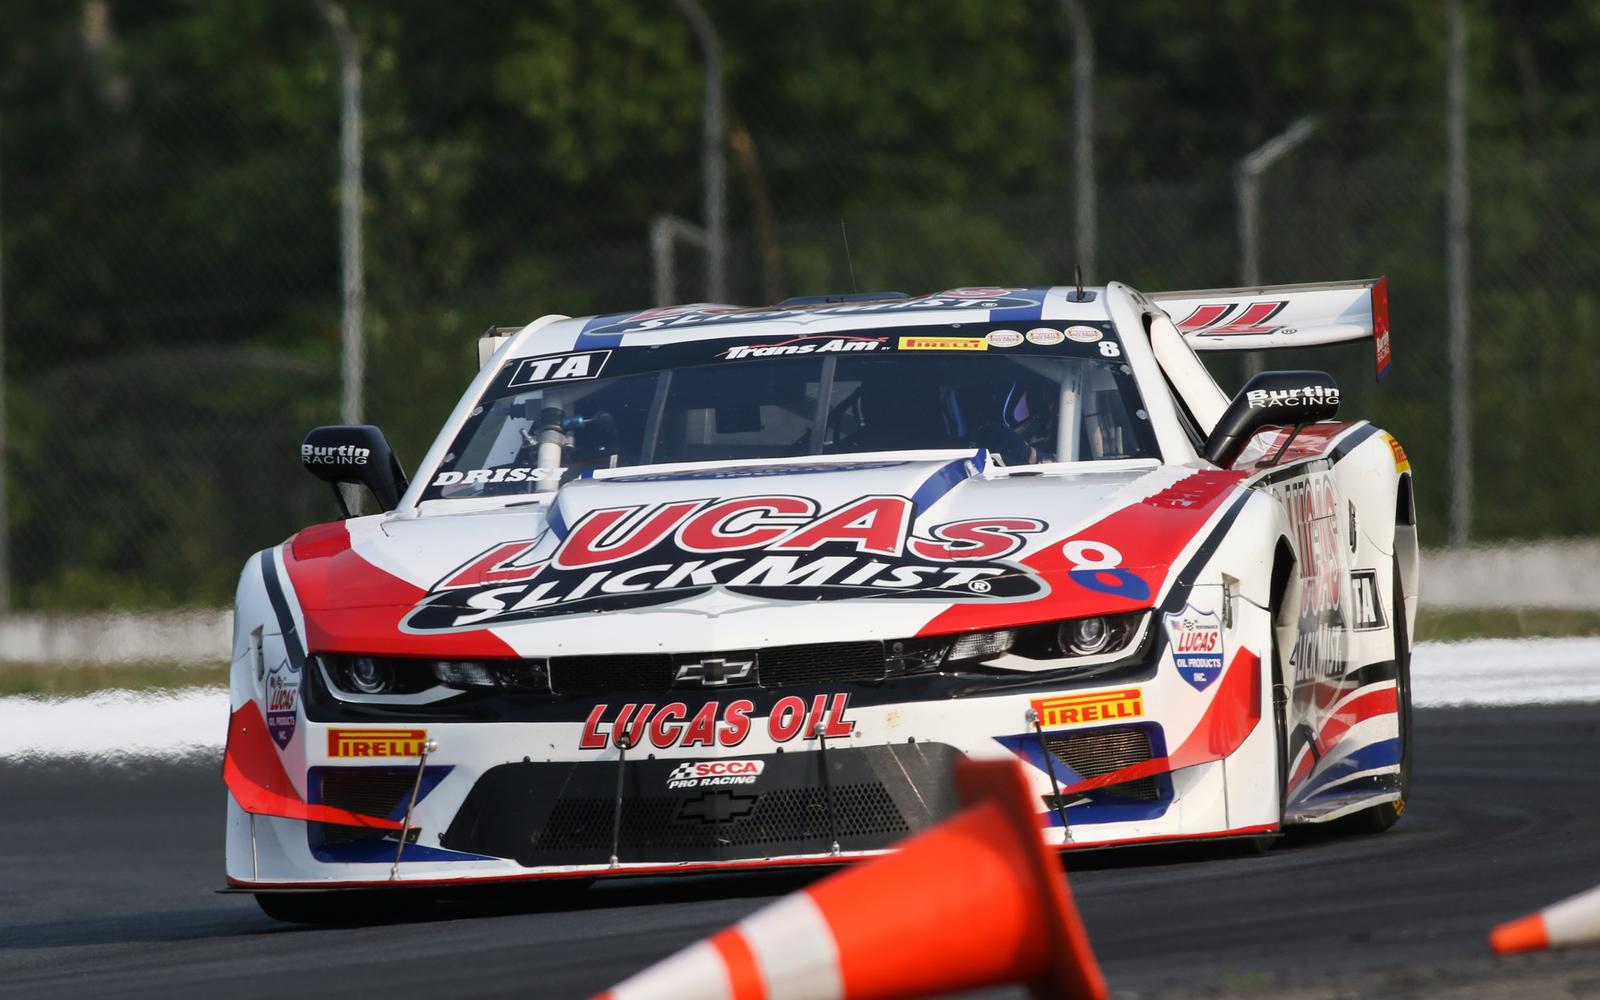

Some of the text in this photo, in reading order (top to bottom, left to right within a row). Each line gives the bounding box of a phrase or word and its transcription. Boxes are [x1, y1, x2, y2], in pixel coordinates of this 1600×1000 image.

[1176, 300, 1290, 337] IL
[725, 339, 879, 360] Trans Am
[906, 338, 981, 349] PIRELLI
[1098, 341, 1121, 358] 8
[528, 355, 591, 382] TA
[1246, 386, 1340, 401] Burtin
[1248, 396, 1340, 409] RACING
[301, 444, 370, 457] Burtin
[301, 455, 368, 465] RACING
[430, 494, 1048, 593] LUCAS
[1062, 540, 1150, 601] 8
[1352, 578, 1377, 623] TA
[1178, 631, 1218, 652] LUCAS
[1177, 658, 1222, 668] OIL PRODUCTS
[270, 689, 297, 710] LUCAS
[1030, 688, 1142, 726] PIRELLI
[579, 692, 856, 750] LUCAS OIL
[328, 728, 428, 757] PIRELLI
[696, 762, 758, 776] SCCA
[668, 776, 757, 789] PRO RACING
